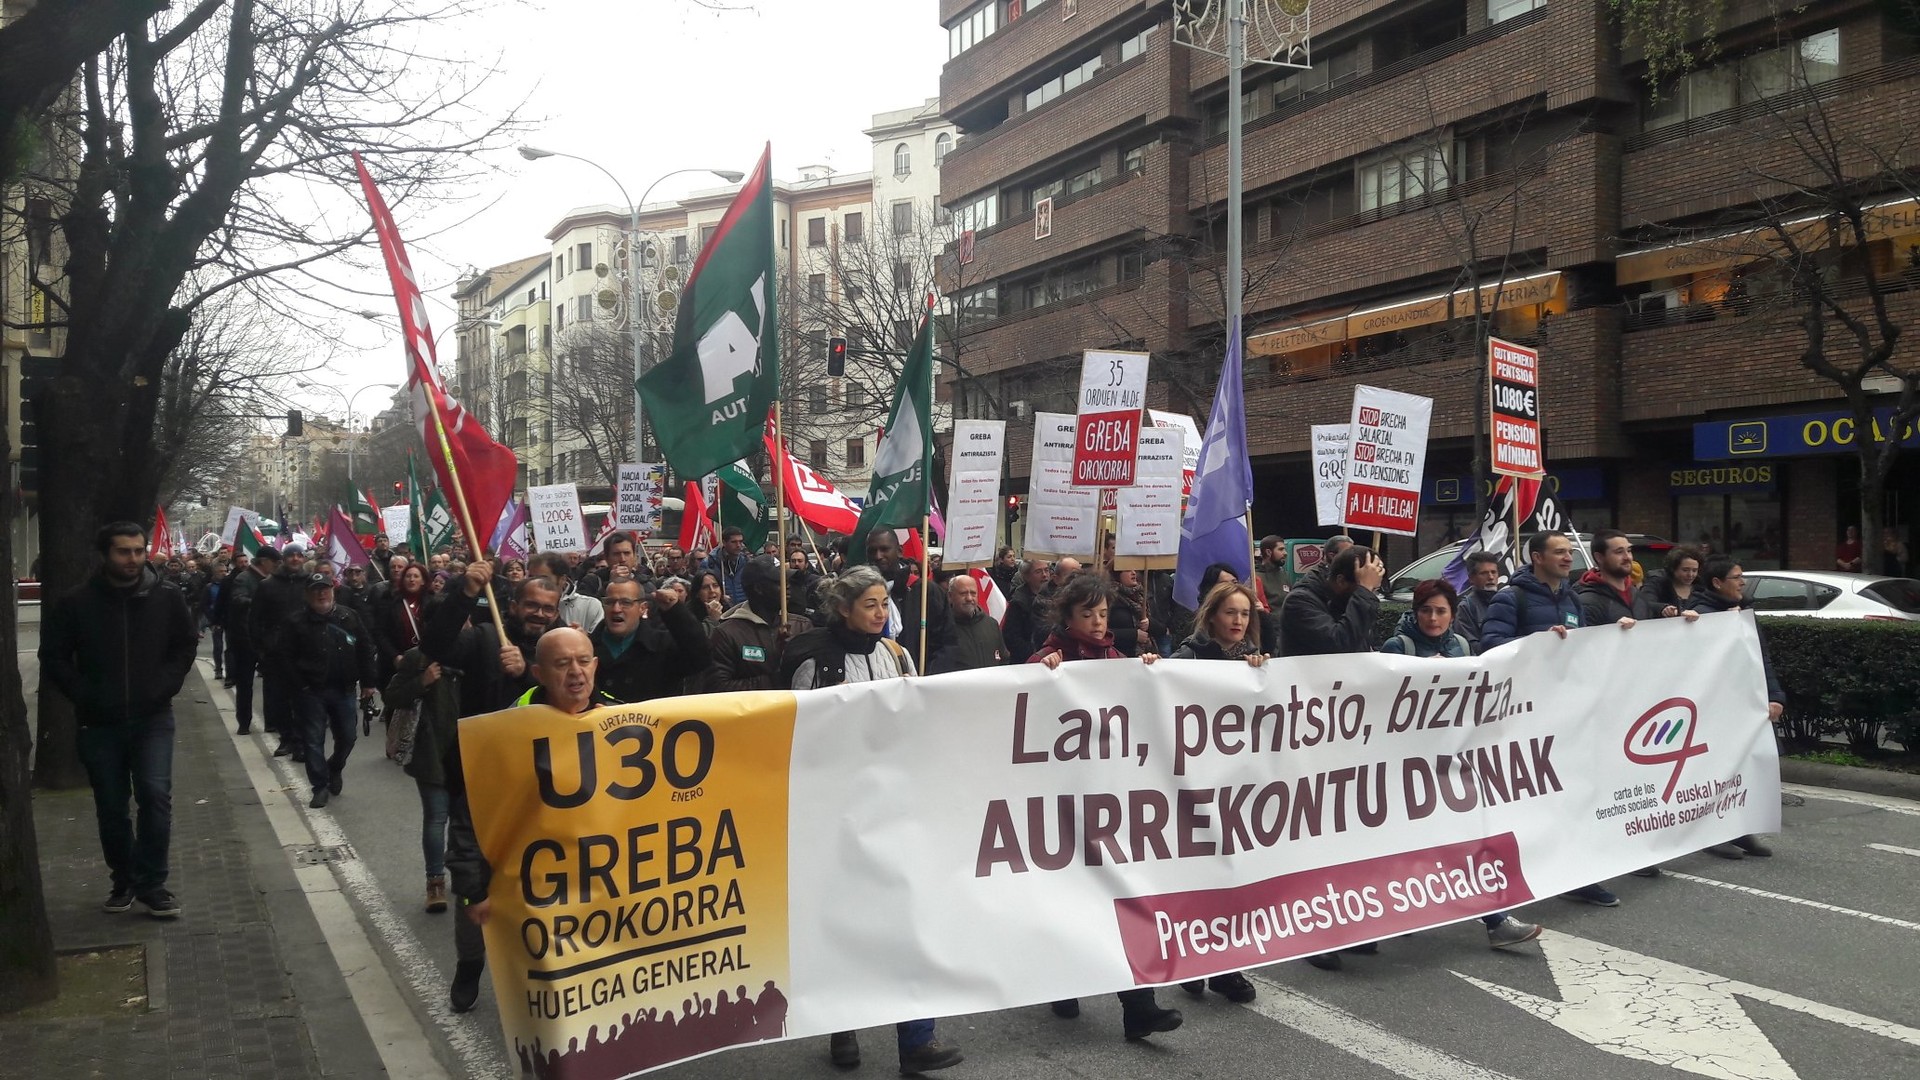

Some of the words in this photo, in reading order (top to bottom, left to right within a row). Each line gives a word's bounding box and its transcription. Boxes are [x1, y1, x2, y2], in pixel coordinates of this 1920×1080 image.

[1363, 308, 1430, 330] GROENLANDIA
[1270, 332, 1318, 349] PELETERIA
[1493, 347, 1534, 369] GUTXIENEKO
[1107, 360, 1124, 387] 35
[1496, 362, 1534, 384] PENTSIOA
[1085, 388, 1118, 407] ORDUEN
[1120, 389, 1140, 408] ALDE
[1494, 384, 1535, 417] 1.080€
[711, 394, 750, 425] AUT
[1360, 409, 1380, 425] STOP
[1381, 411, 1407, 430] BRECHA
[1085, 420, 1131, 452] GREBA
[1358, 427, 1393, 446] SALARIAL
[1496, 420, 1536, 445] PENSIÓN
[1356, 443, 1375, 460] STOP
[1376, 447, 1402, 464] BRECHA
[1404, 451, 1415, 466] EN
[1497, 441, 1538, 468] MÍNIMA
[621, 471, 640, 480] HACIA
[642, 471, 651, 480] LA
[1078, 459, 1131, 480] OROKORRA!
[1354, 463, 1368, 478] LAS
[1370, 465, 1410, 485] PENSIONES
[1669, 466, 1772, 487] SEGUROS
[620, 482, 650, 492] JUSTICIA
[621, 493, 642, 503] SOCIAL
[620, 504, 644, 513] HUELGA
[1349, 493, 1359, 516] ¡A
[1362, 494, 1374, 514] LA
[1377, 495, 1415, 519] HUELGA!
[557, 524, 570, 534] LA
[599, 712, 660, 733] URTARRILA
[1011, 692, 1149, 767] Lan,
[1174, 681, 1372, 776] pentsio,
[1387, 670, 1534, 734] bizitza...
[532, 719, 715, 809] U30
[671, 787, 704, 803] ENERO
[1613, 787, 1632, 801] carta
[1633, 785, 1643, 797] de
[1643, 783, 1656, 795] los
[1676, 781, 1712, 805] euskal
[975, 761, 1387, 878] AURREKONTU
[1595, 802, 1627, 820] derechos
[1627, 797, 1658, 813] sociales
[1624, 813, 1676, 837] eskubide
[1678, 802, 1715, 824] sozialen
[519, 808, 746, 908] GREBA
[1154, 881, 1381, 960] Presupuestos
[1387, 855, 1508, 916] sociales
[521, 878, 746, 961] OROKORRA
[527, 973, 626, 1020] HUELGA
[632, 944, 751, 994] GENERAL
